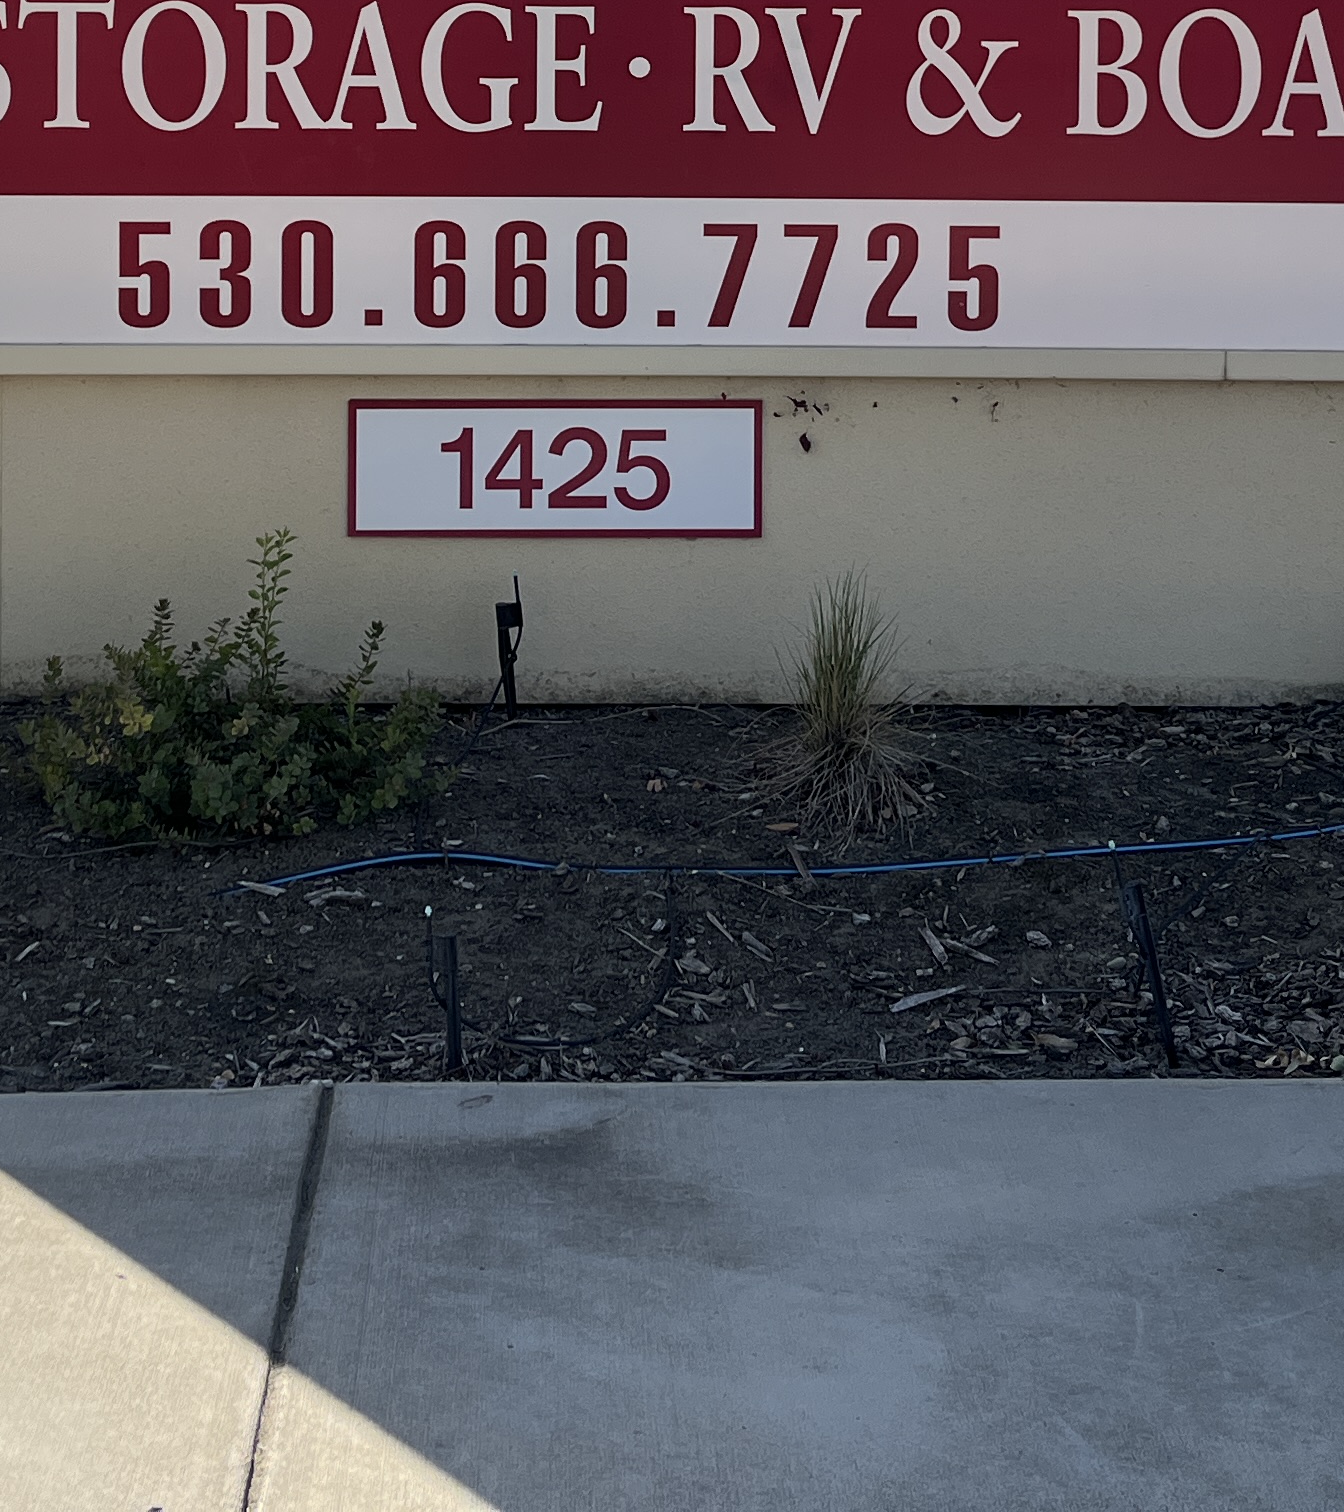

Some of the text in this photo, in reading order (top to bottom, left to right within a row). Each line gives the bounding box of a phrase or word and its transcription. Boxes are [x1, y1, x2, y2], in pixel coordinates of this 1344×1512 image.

[681, 5, 863, 136] RV
[905, 6, 1023, 138] &
[118, 218, 1002, 332] 530.666.7725
[441, 426, 672, 511] 1425
